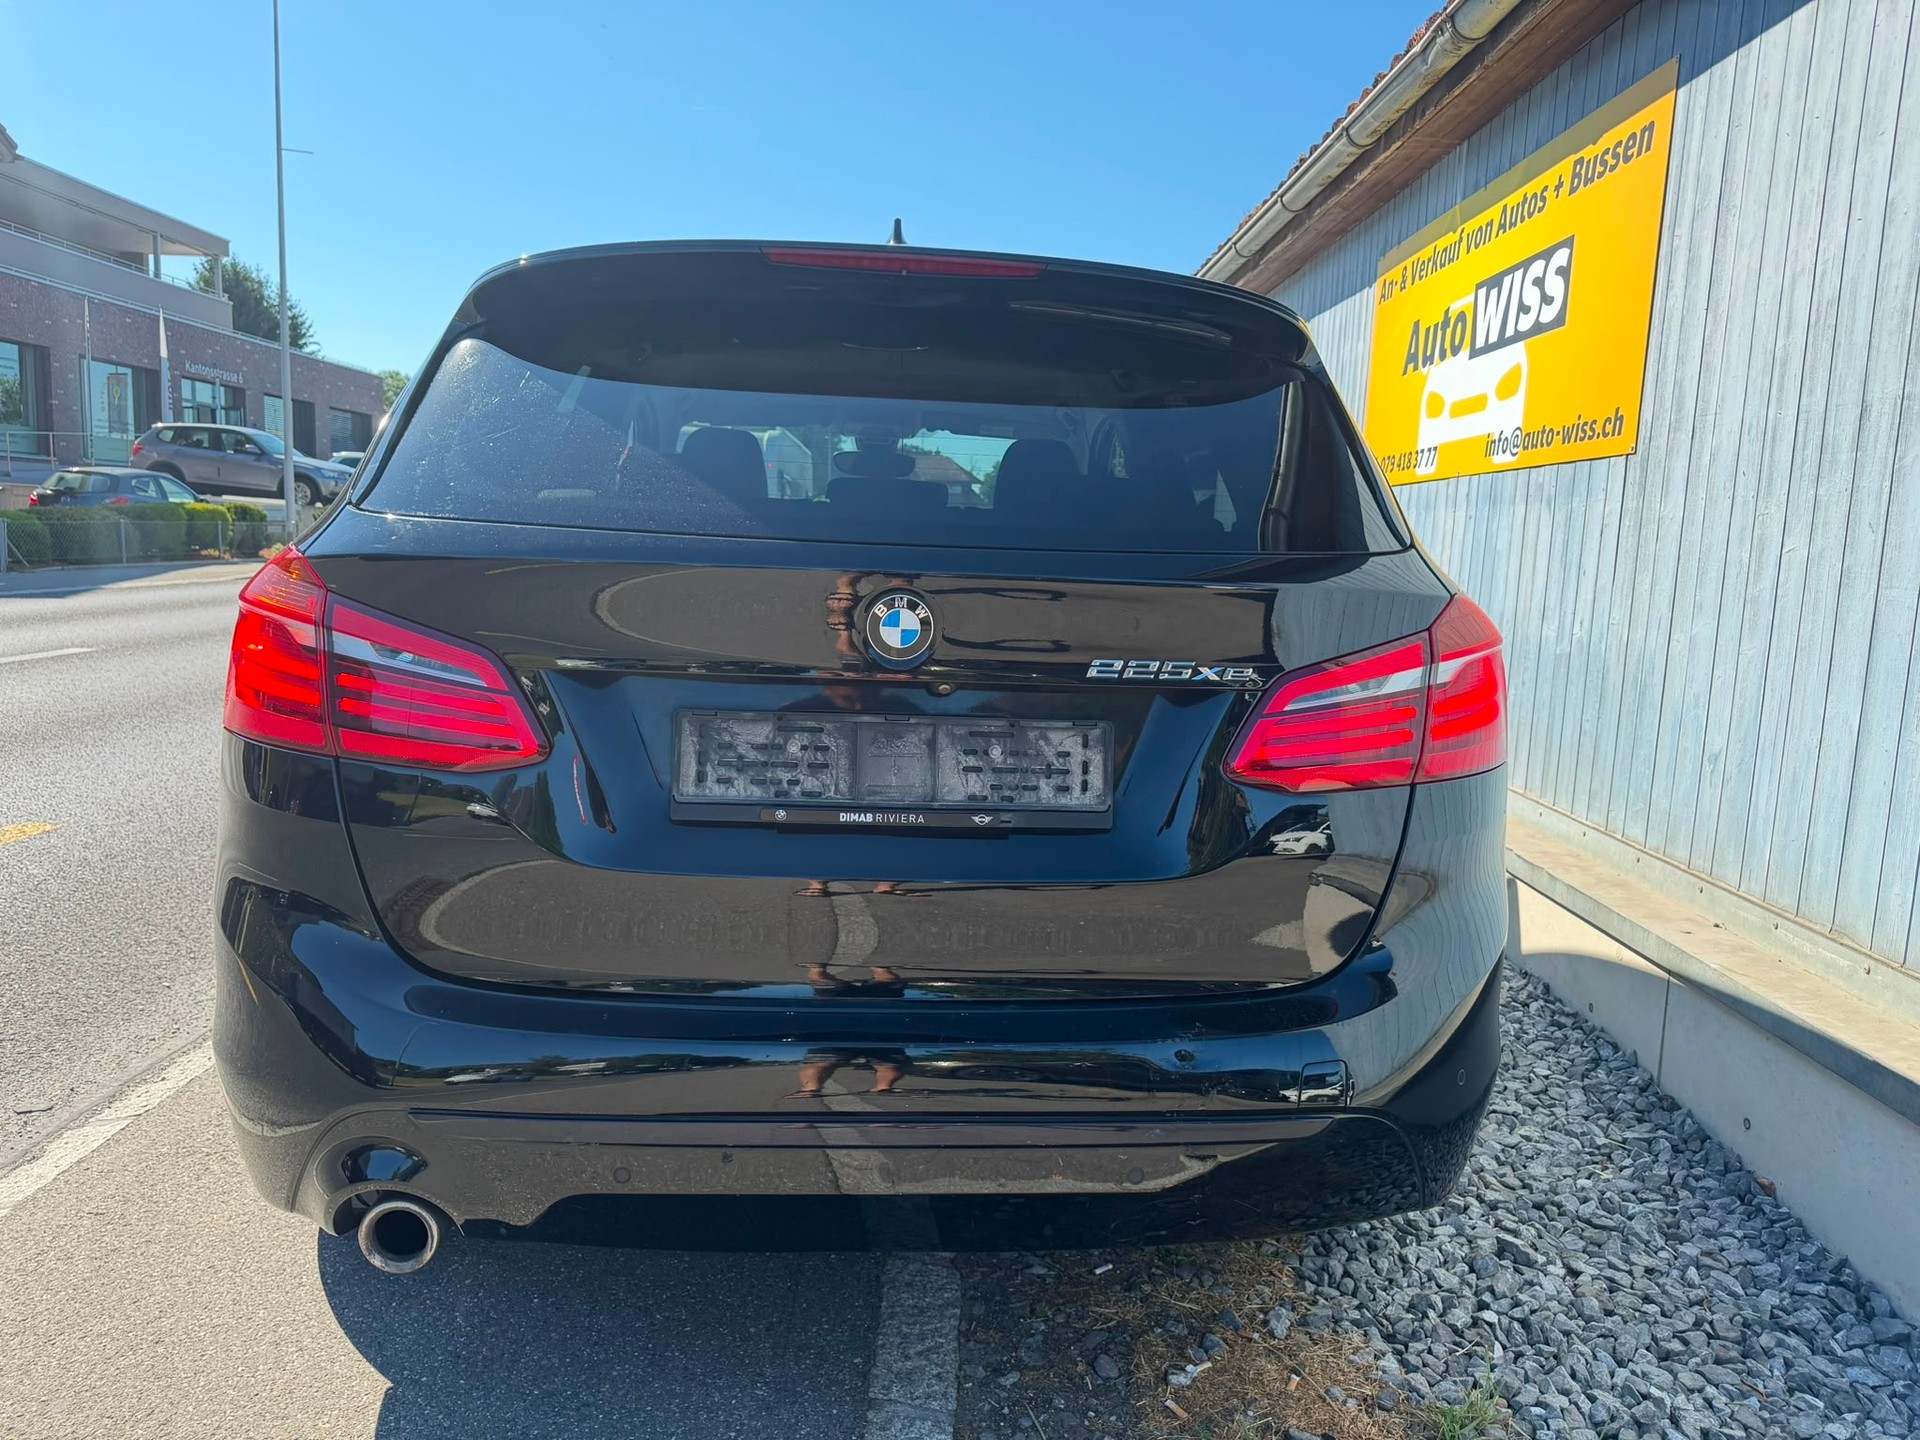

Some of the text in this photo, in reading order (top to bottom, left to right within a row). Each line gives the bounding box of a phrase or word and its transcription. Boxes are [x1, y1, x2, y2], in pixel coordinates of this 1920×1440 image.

[1379, 120, 1656, 305] An- & Verkauf von Autos + Bussen
[1402, 247, 1571, 376] Auto WISS
[185, 359, 244, 384] Kantonsstrasse 6
[1485, 406, 1625, 458] info@auto-wiss.ch
[1381, 446, 1438, 474] 079 418 37 77
[874, 597, 928, 619] BMW
[1086, 659, 1253, 681] 225xe
[839, 812, 925, 824] DIMAB RIVIERA
